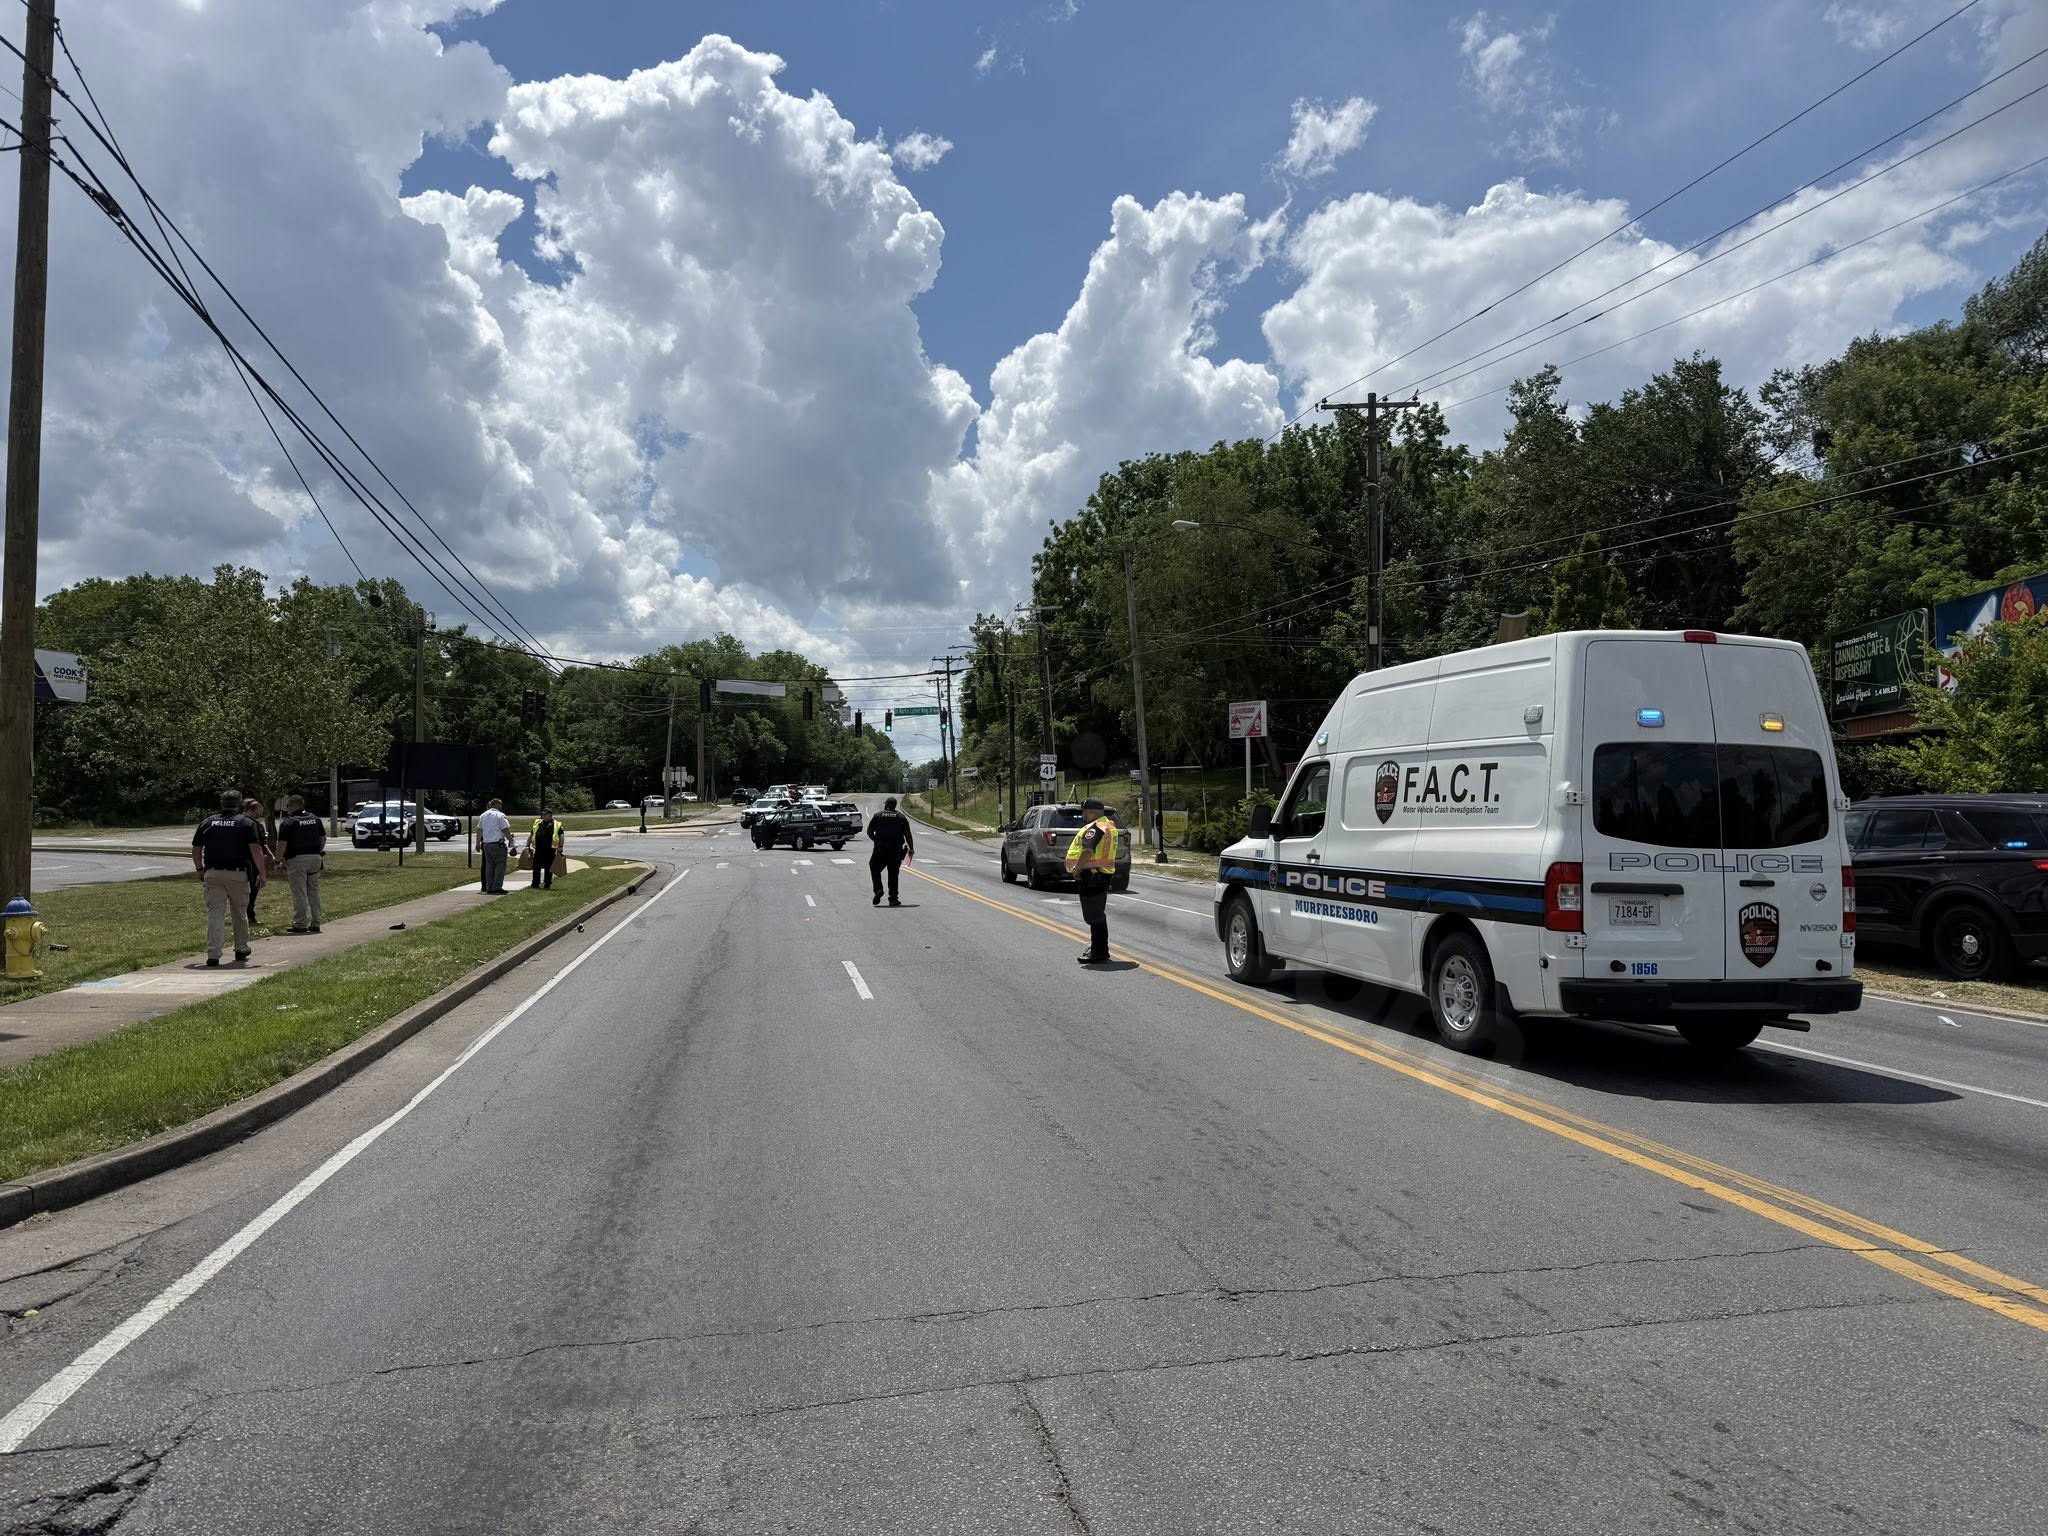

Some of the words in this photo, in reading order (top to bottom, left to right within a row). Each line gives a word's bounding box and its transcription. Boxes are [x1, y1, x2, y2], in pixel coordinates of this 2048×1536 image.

[1835, 643, 1866, 665] CANNABIS
[1885, 637, 1891, 653] &
[54, 667, 83, 677] COOK'S
[1836, 659, 1872, 680] DISPENSARY
[1043, 766, 1053, 776] 41
[1376, 763, 1398, 783] POLICE
[1403, 763, 1500, 803] F.A.C.T.
[1450, 806, 1483, 815] Investigation
[1609, 852, 1823, 874] POLICE
[1286, 871, 1386, 899] POLICE
[1295, 900, 1378, 924] MURFREESBORO
[1615, 905, 1654, 918] 7184-GF
[1741, 904, 1777, 925] POLICE
[1799, 924, 1837, 932] NV2500
[1631, 963, 1658, 975] 1856
